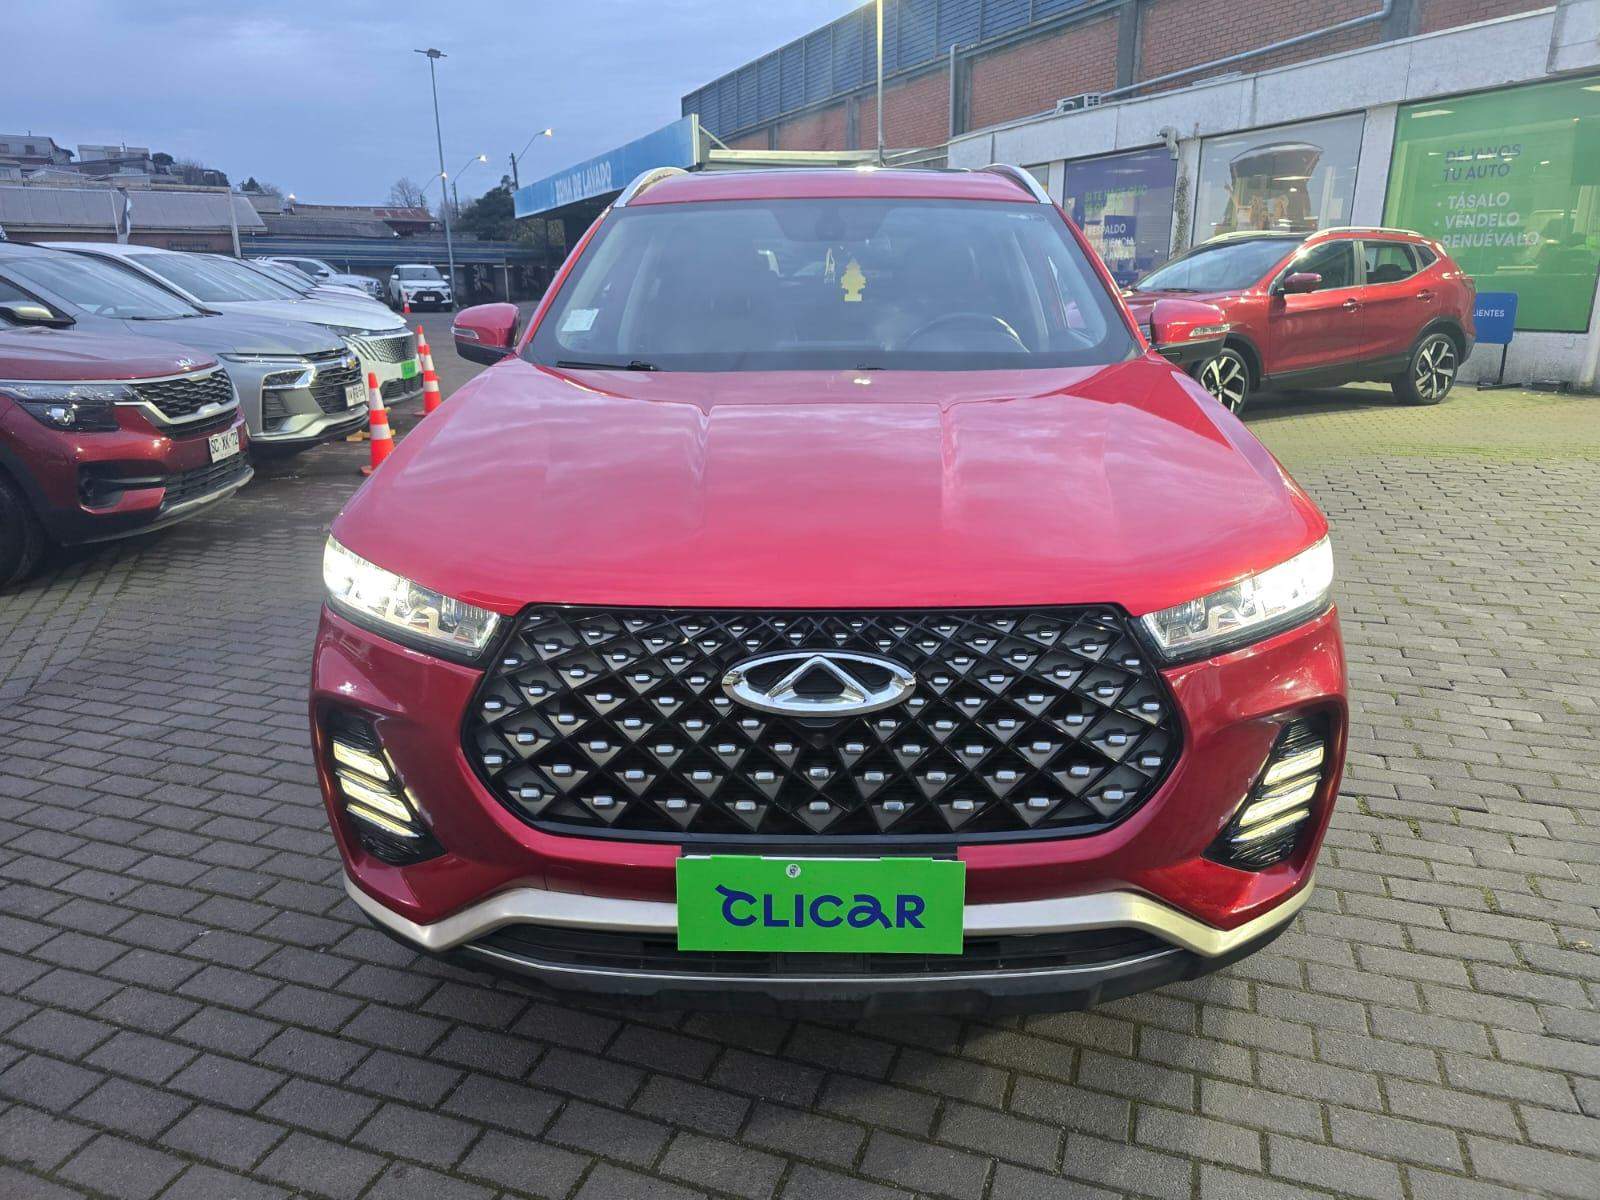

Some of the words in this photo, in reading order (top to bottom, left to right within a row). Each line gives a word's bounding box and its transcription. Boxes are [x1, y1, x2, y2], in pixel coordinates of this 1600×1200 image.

[1443, 167, 1462, 181] TU
[1465, 163, 1511, 180] AUTO
[1447, 191, 1510, 210] TÁSALO
[1445, 210, 1520, 229] VÉNDELO
[1441, 230, 1540, 248] RENUÉVALO
[1472, 309, 1505, 317] LIENTES
